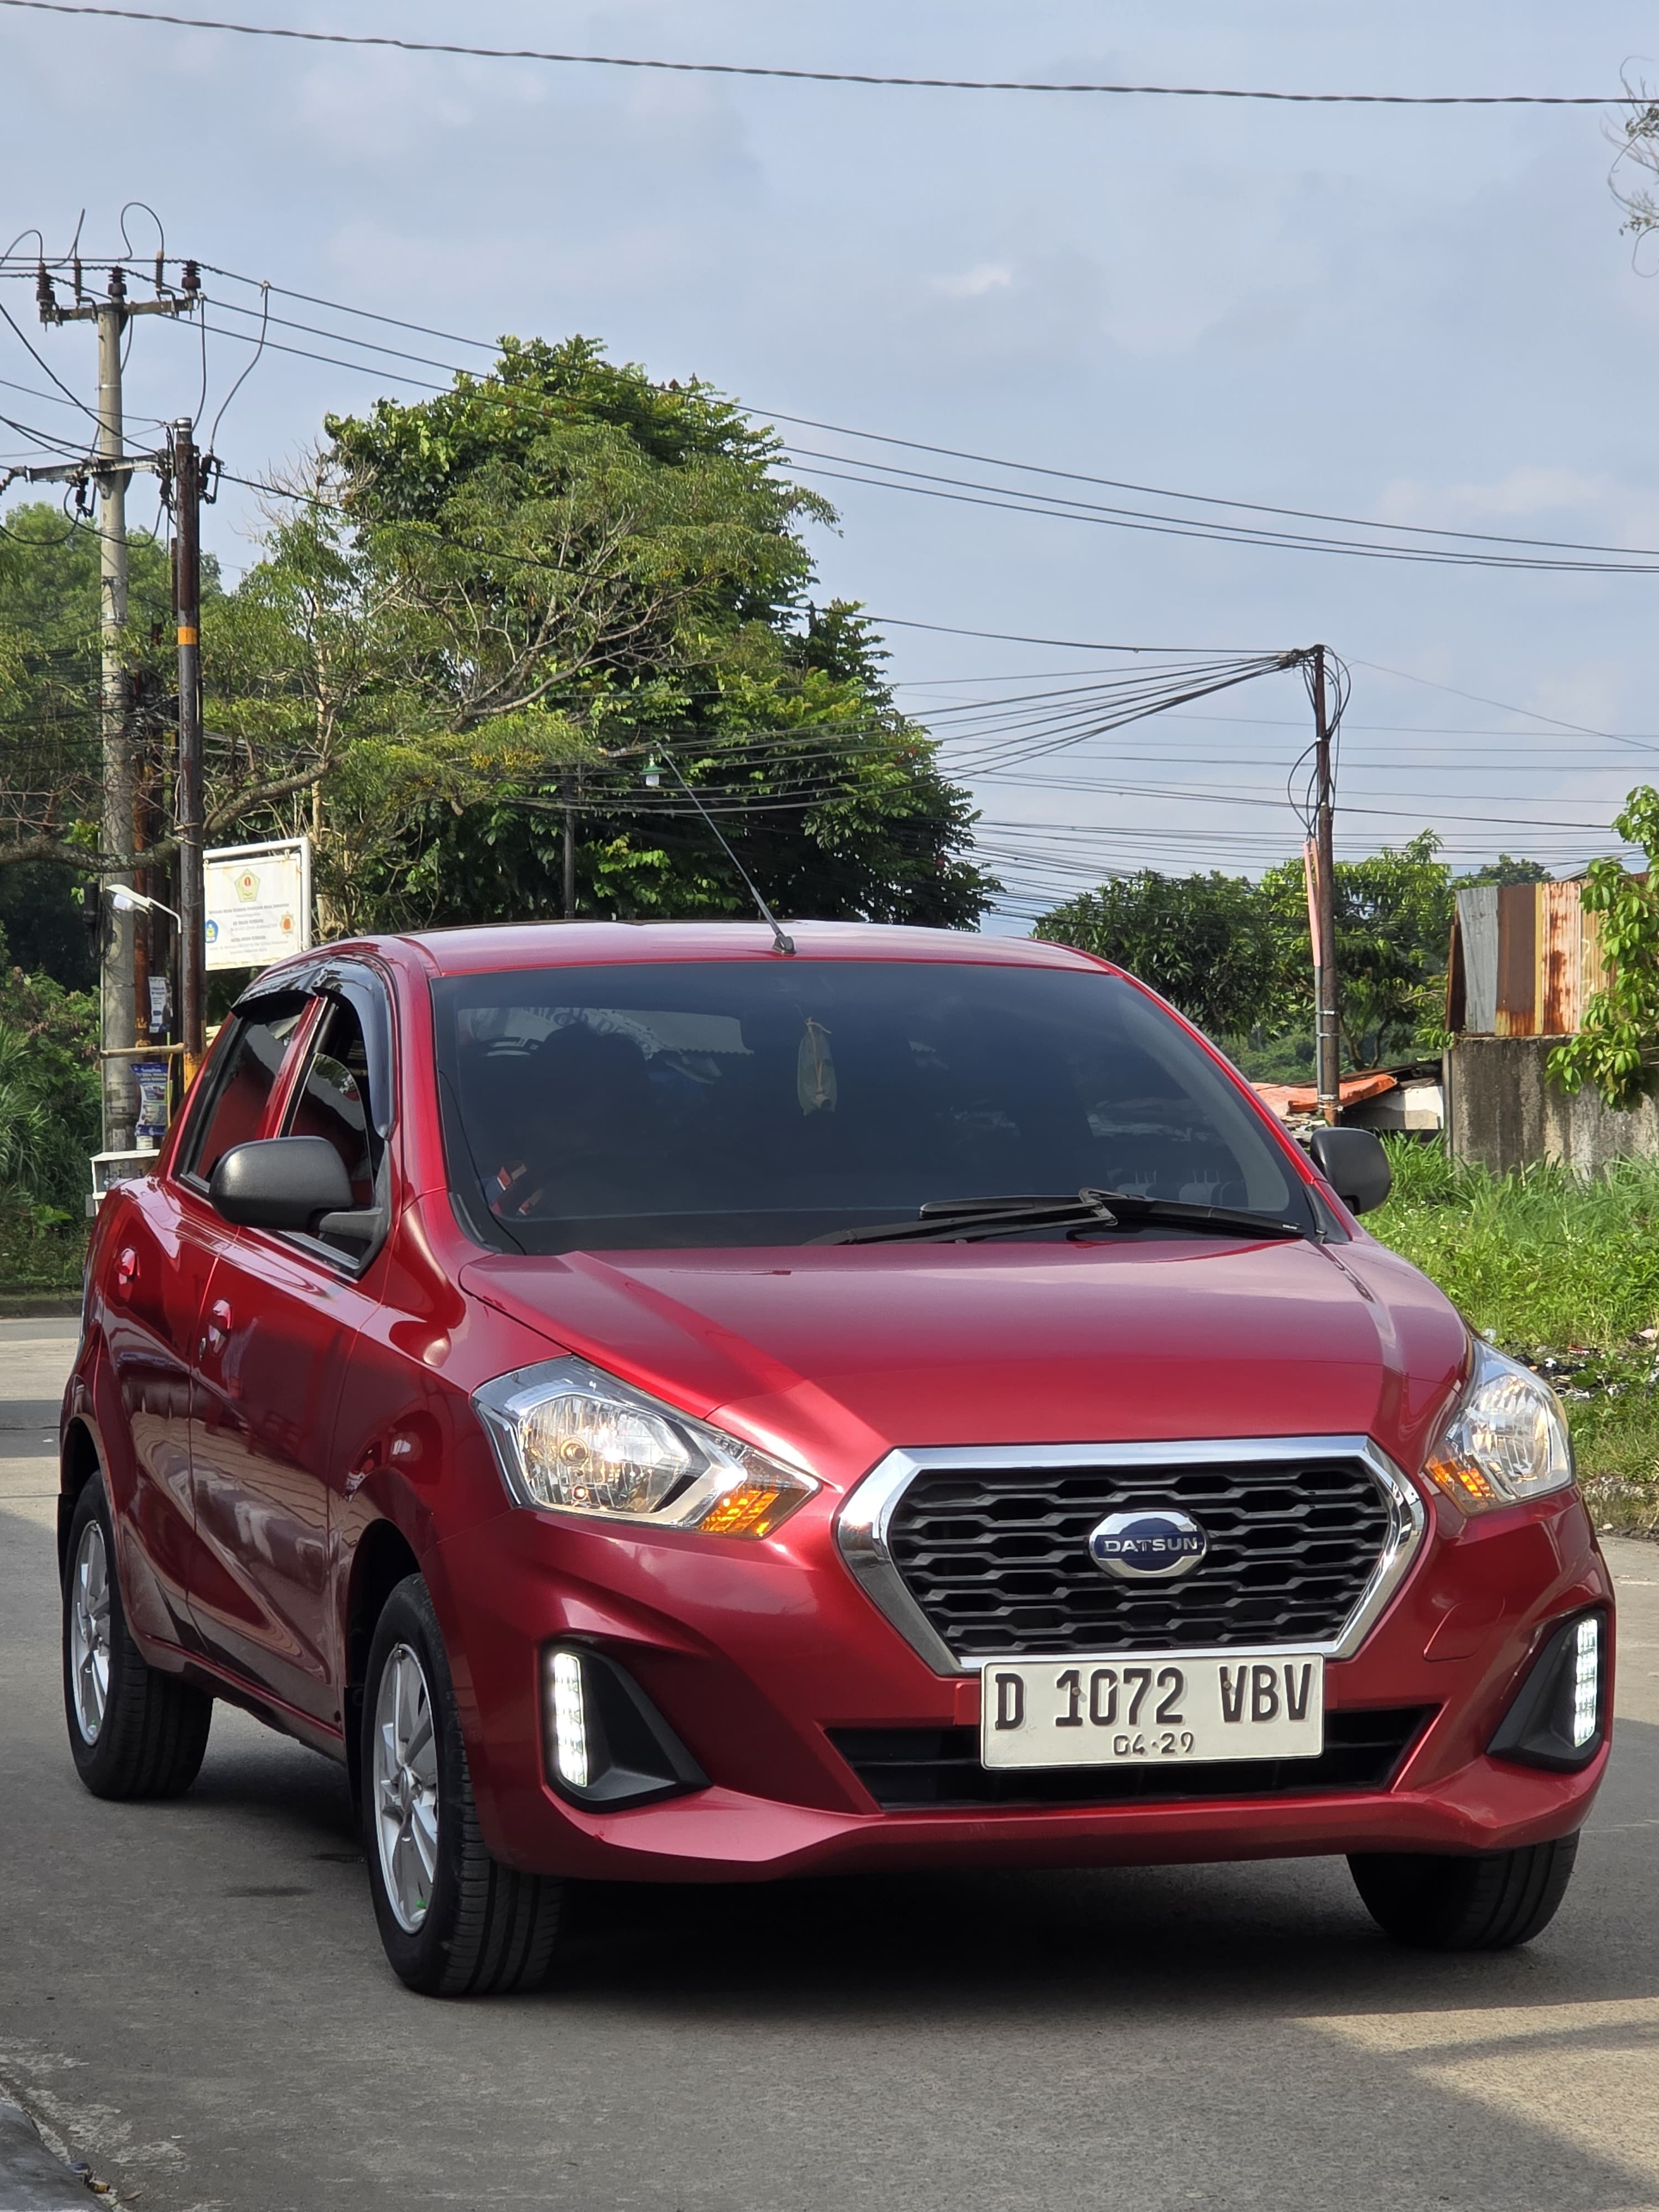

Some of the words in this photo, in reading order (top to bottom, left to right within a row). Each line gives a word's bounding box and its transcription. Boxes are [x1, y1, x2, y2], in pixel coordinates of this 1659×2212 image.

[1104, 1537, 1197, 1552] DATSUN
[995, 1673, 1024, 1730] D
[1055, 1667, 1184, 1727] 1072
[1219, 1663, 1312, 1723] VBV
